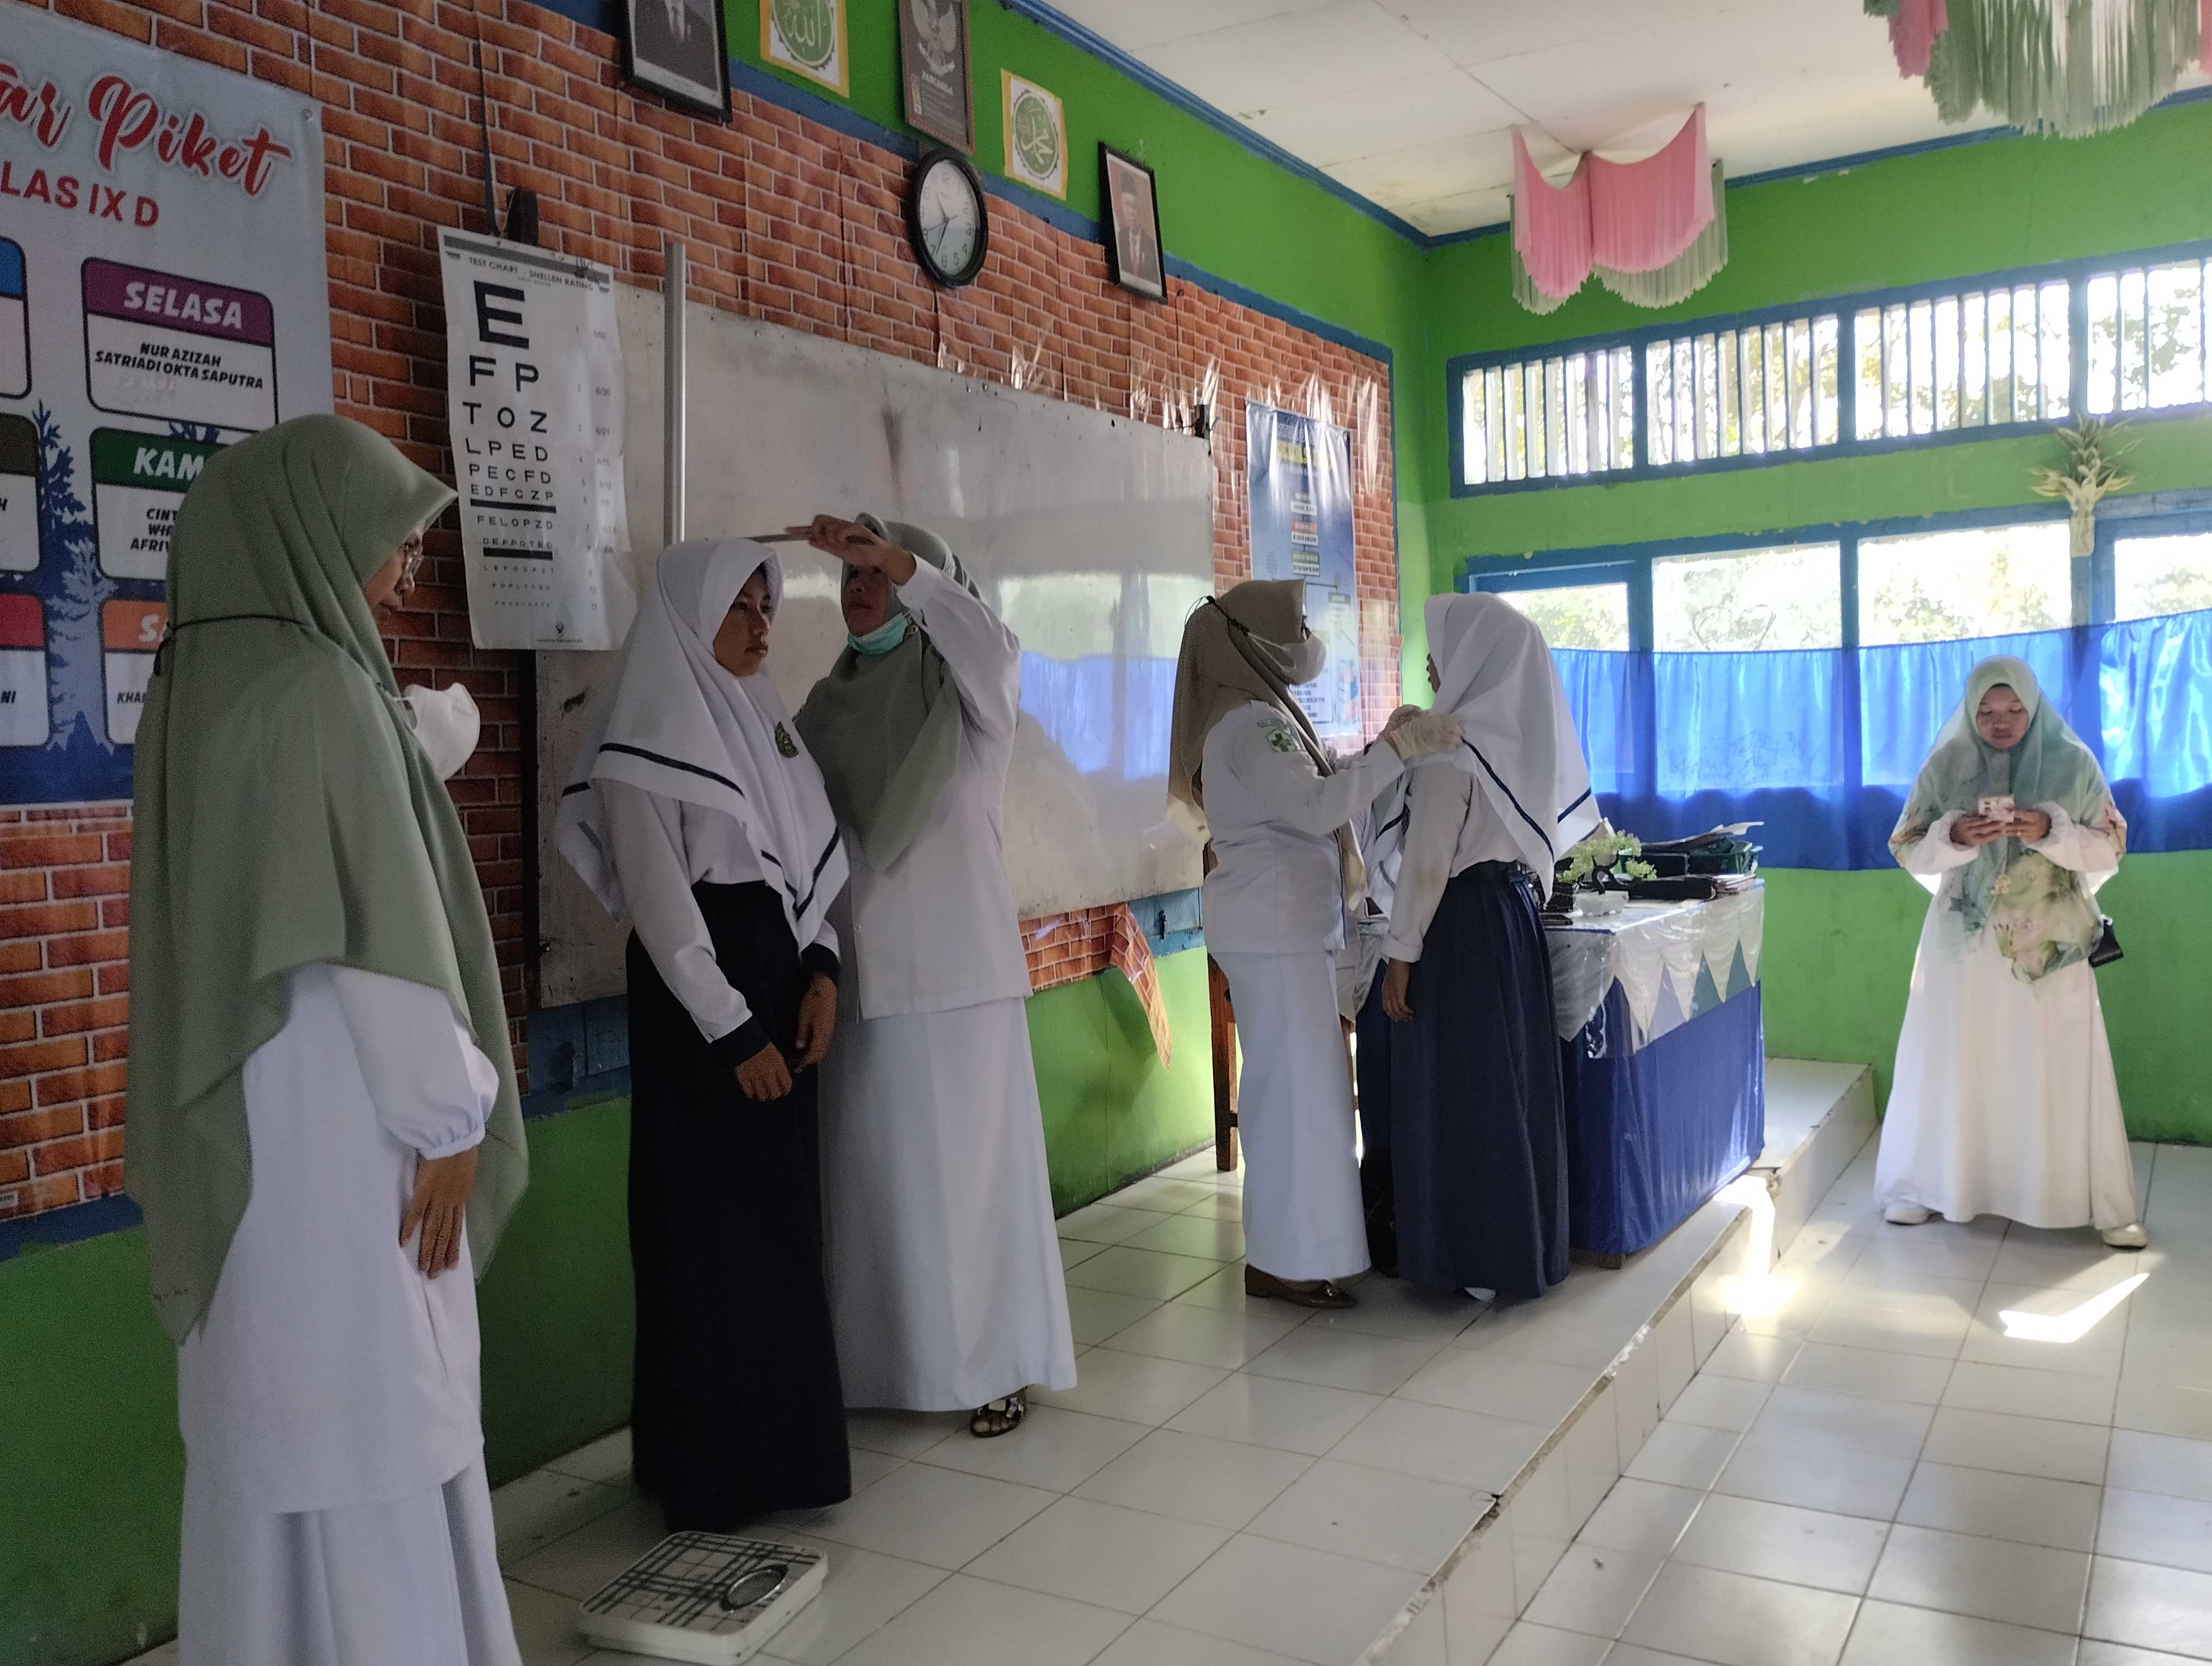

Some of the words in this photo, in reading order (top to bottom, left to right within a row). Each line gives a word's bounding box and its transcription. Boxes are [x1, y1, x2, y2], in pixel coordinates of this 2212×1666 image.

[88, 75, 292, 197] Piket
[89, 183, 127, 222] IX
[134, 195, 159, 227] D
[469, 257, 486, 267] TEST
[488, 260, 518, 273] CHART
[124, 281, 243, 329] SELASA
[473, 280, 529, 350] E
[95, 350, 161, 373] SATRIADI
[164, 362, 199, 379] OKTA
[201, 369, 264, 390] SAPUTRA
[140, 343, 170, 357] NUR
[172, 348, 222, 367] AZIZAH
[469, 355, 496, 387] F
[515, 362, 539, 393] P
